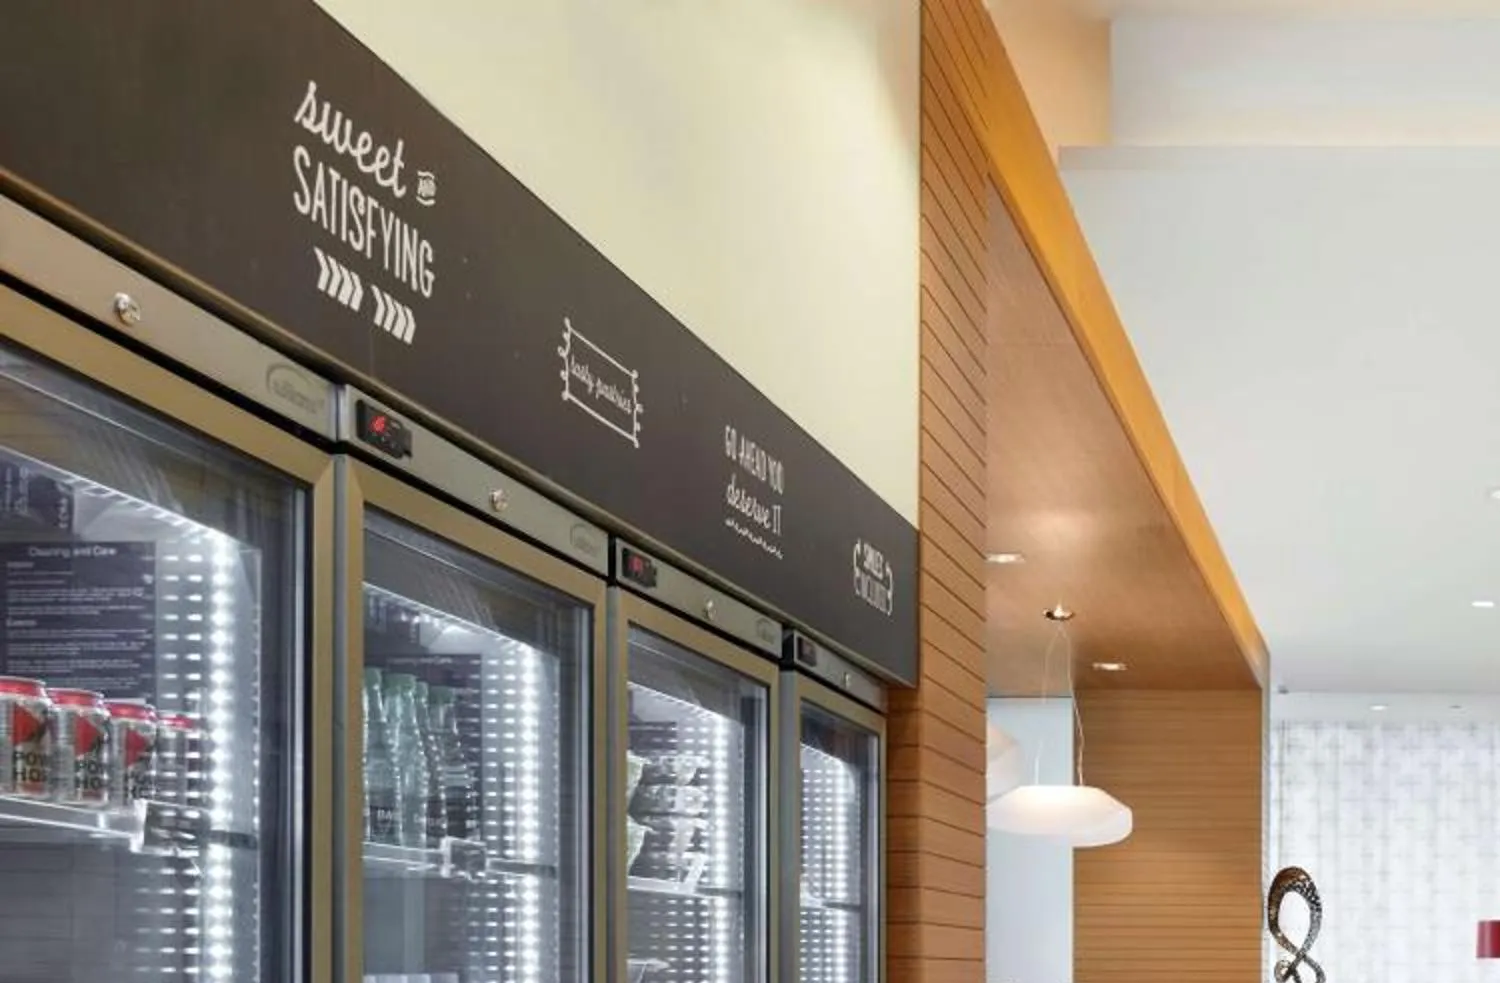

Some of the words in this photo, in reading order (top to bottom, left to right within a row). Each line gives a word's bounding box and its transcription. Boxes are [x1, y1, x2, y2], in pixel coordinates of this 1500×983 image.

[294, 79, 406, 198] sweet
[293, 144, 435, 298] SATISFYING
[726, 472, 771, 529] deserve
